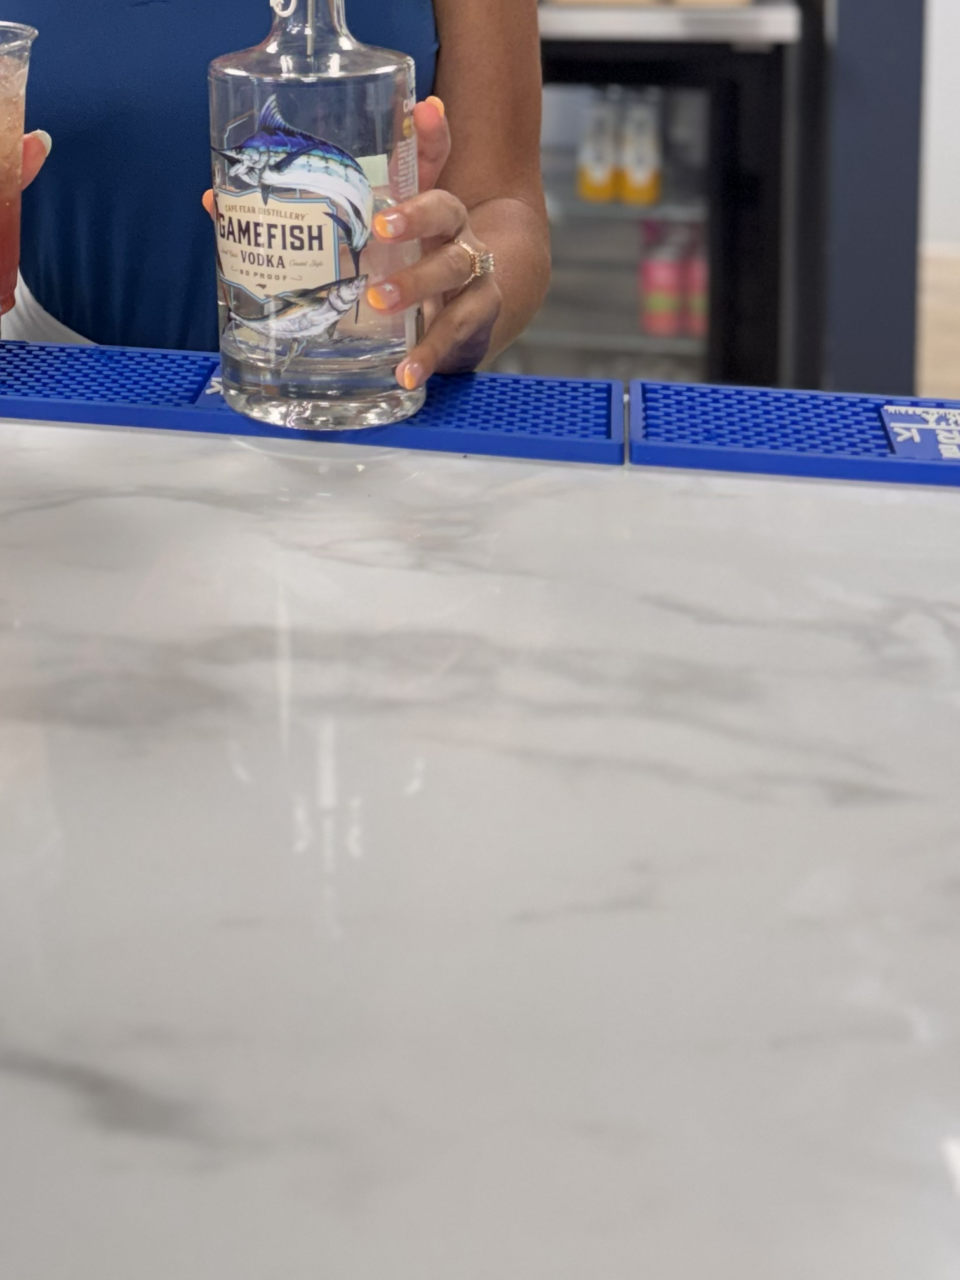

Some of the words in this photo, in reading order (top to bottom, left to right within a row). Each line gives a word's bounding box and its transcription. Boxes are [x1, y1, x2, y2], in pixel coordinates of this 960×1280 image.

[257, 207, 307, 222] DISTILLERY
[218, 213, 324, 252] GAMEFISH
[240, 249, 286, 269] VODKA
